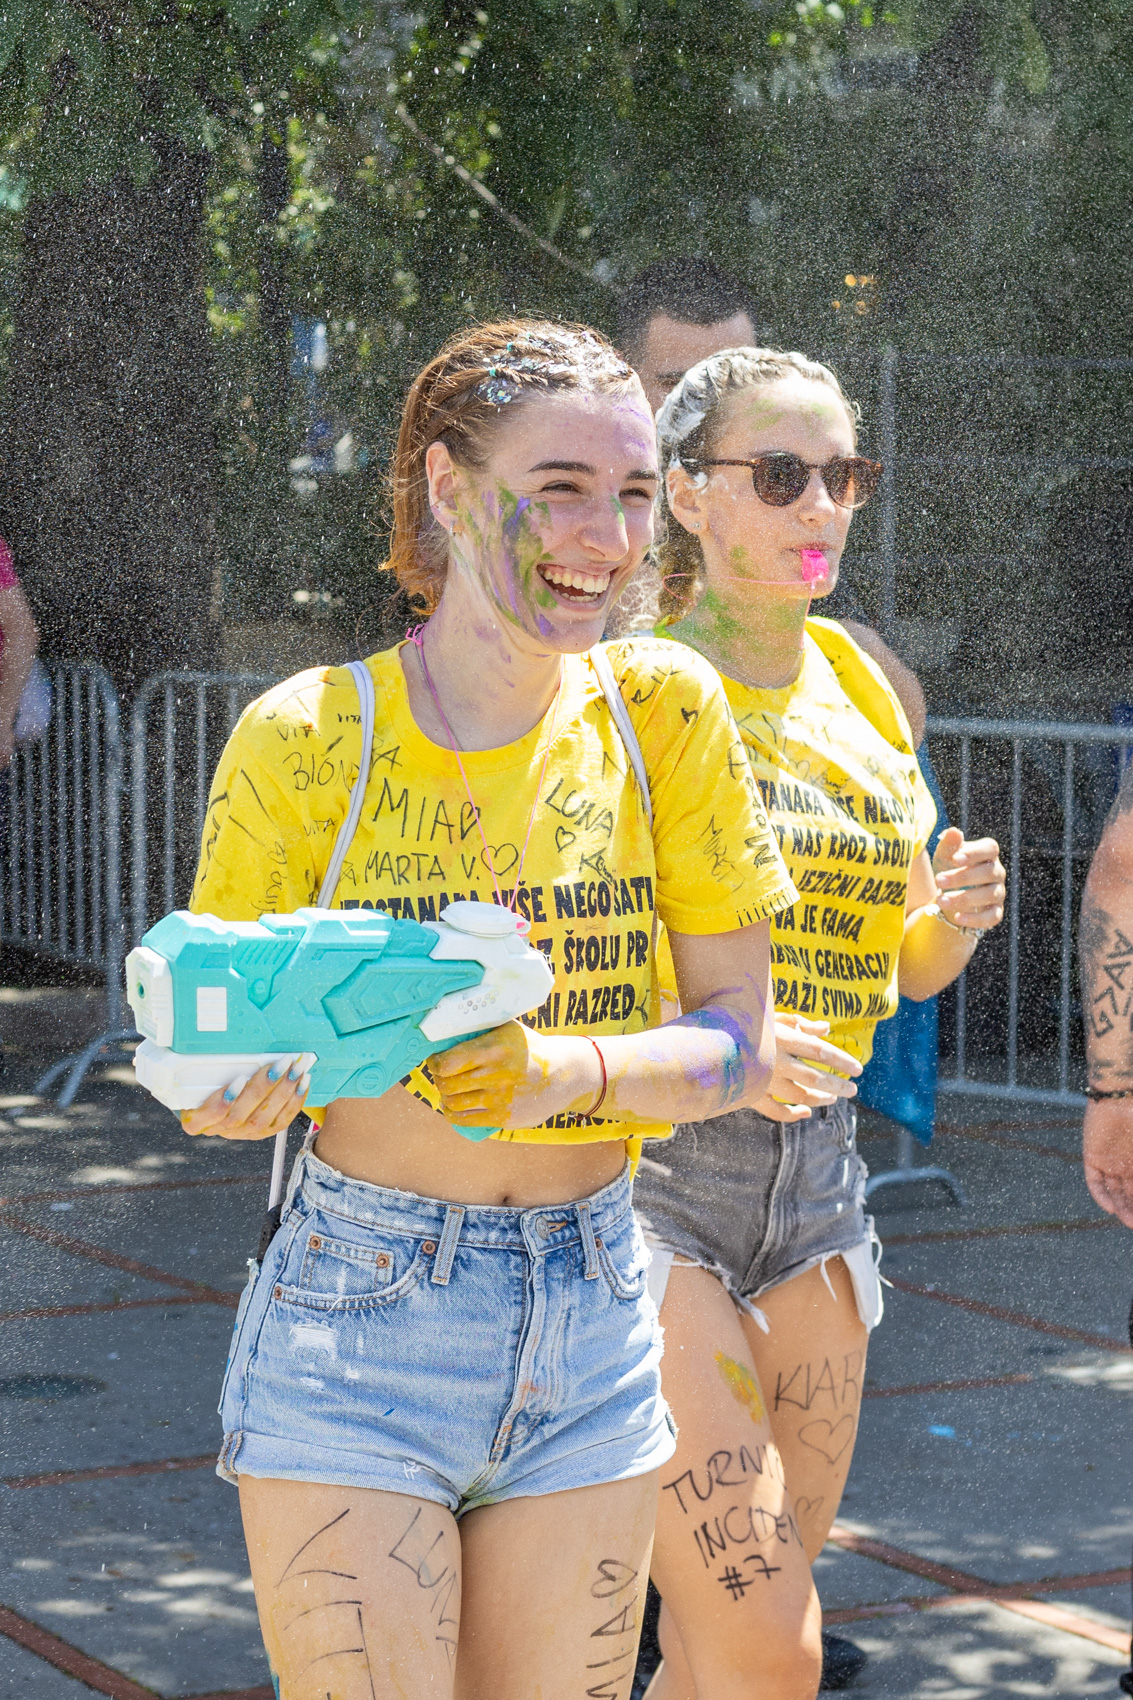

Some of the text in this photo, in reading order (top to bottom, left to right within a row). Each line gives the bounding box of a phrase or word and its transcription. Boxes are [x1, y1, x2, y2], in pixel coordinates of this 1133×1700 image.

[372, 778, 454, 844] MIA
[545, 777, 613, 839] LUNA
[791, 826, 824, 859] NAS
[364, 850, 446, 886] MARTA
[460, 853, 480, 881] V.
[800, 904, 818, 934] JE
[563, 929, 621, 975] ŠKOLU
[564, 983, 636, 1027] RAZRED
